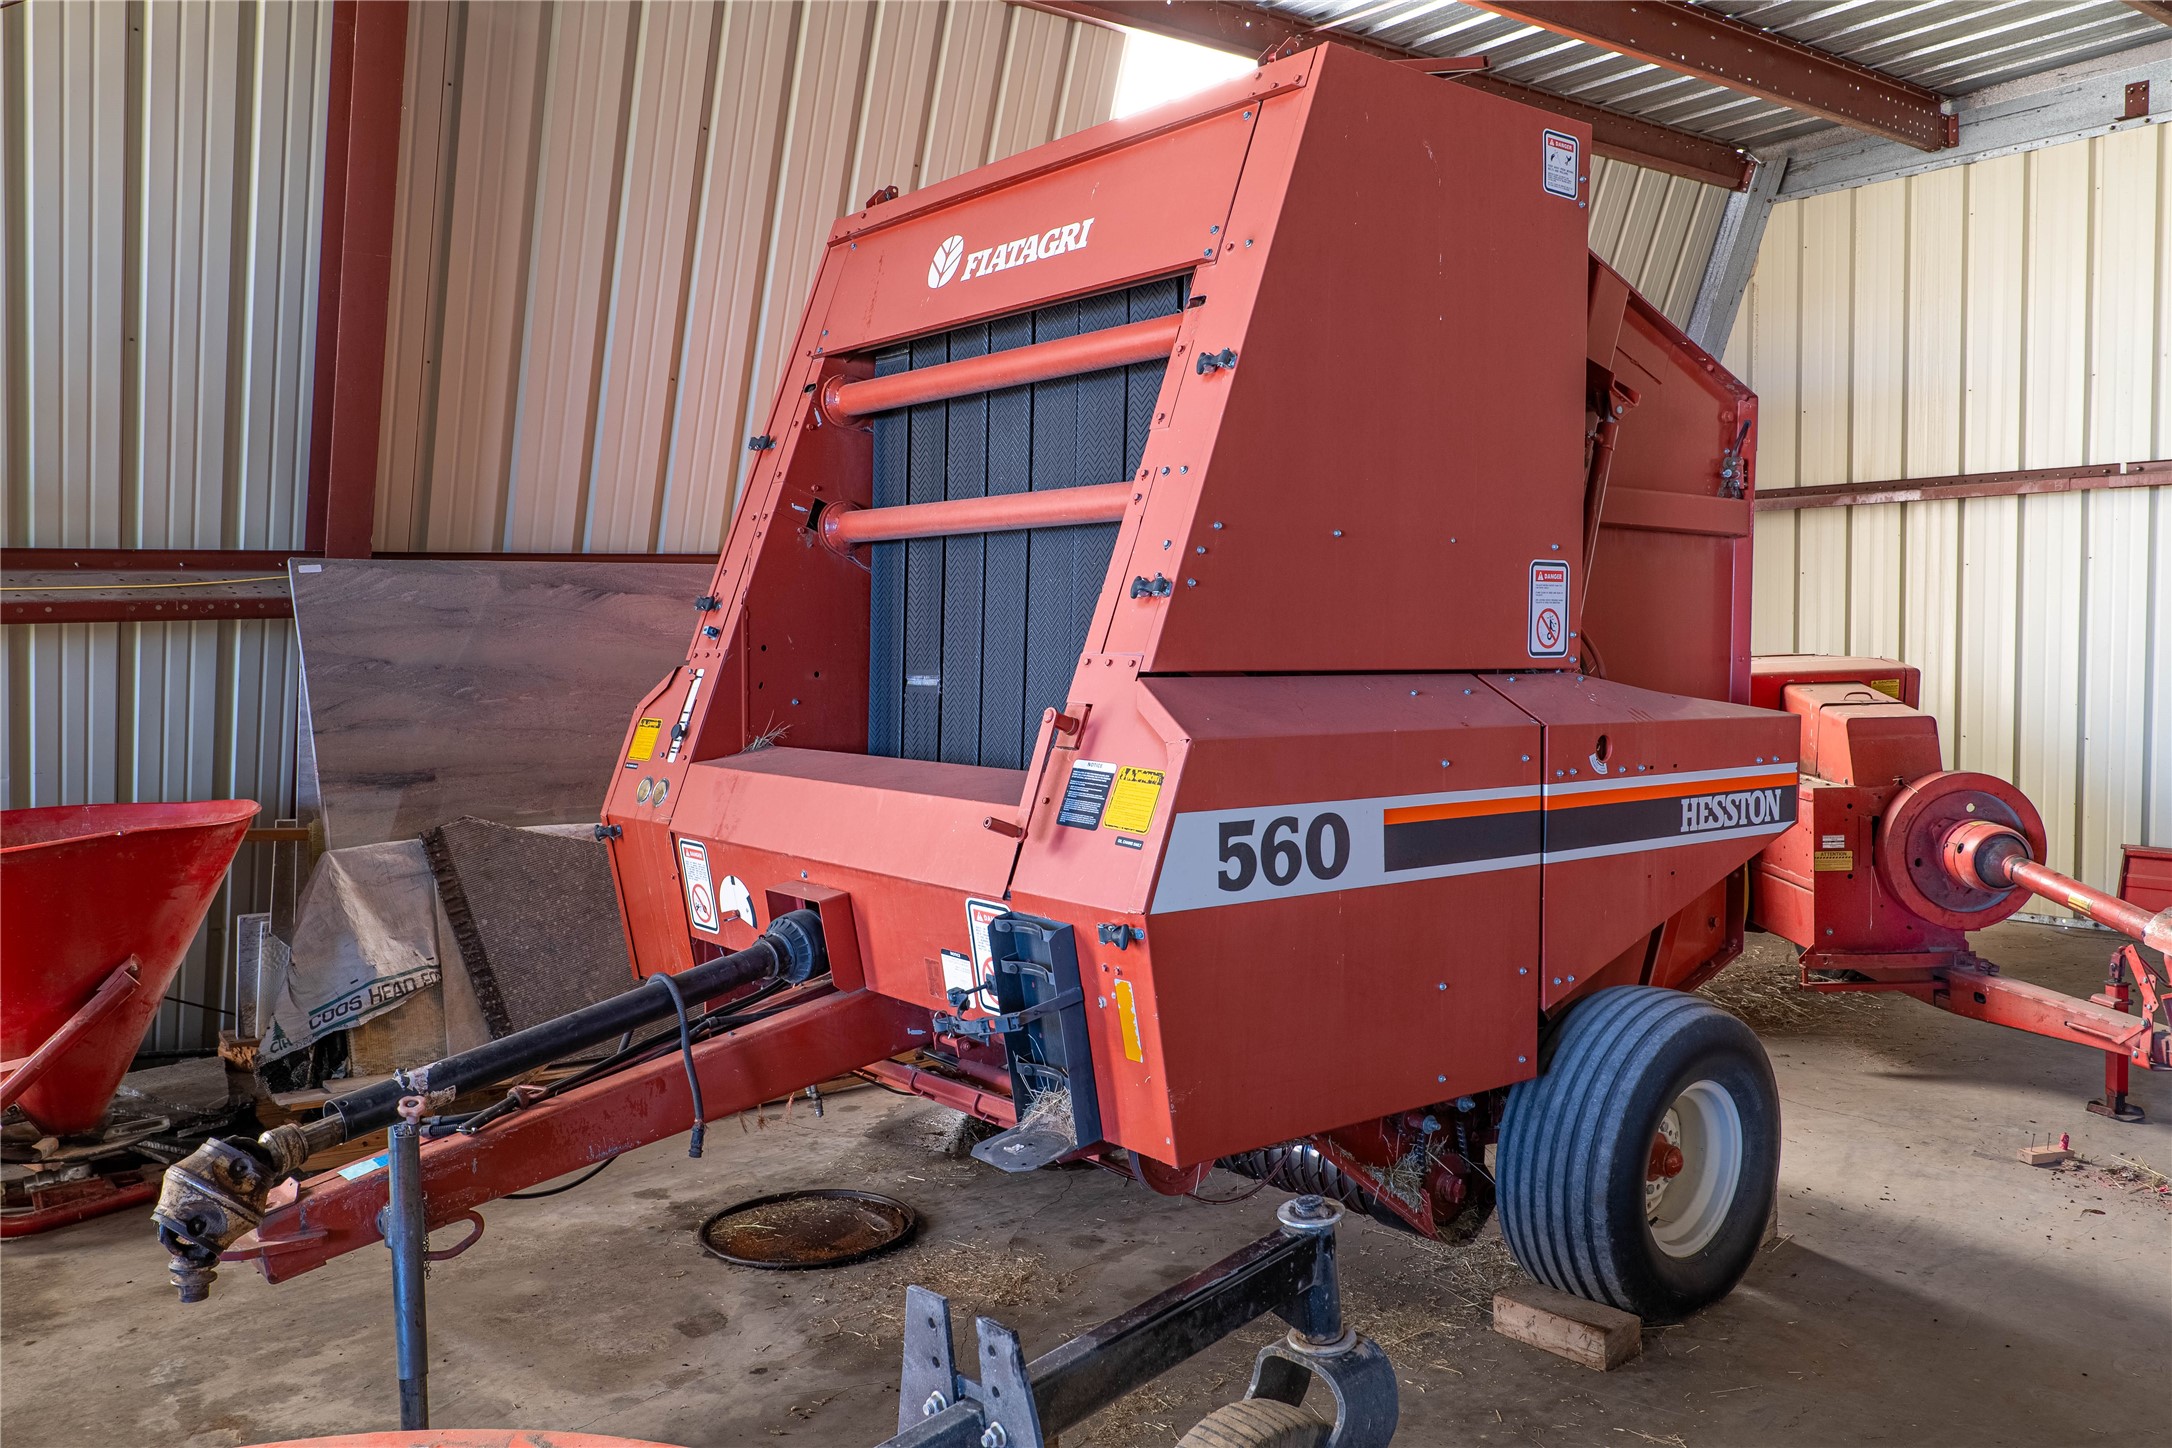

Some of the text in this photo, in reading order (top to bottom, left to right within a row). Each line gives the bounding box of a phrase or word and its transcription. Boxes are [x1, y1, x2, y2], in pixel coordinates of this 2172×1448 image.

[960, 217, 1095, 282] FIATAGRI
[1680, 788, 1781, 832] HESSTON
[1218, 812, 1350, 891] 560
[308, 995, 363, 1030] COOS
[368, 977, 418, 1005] HEAD
